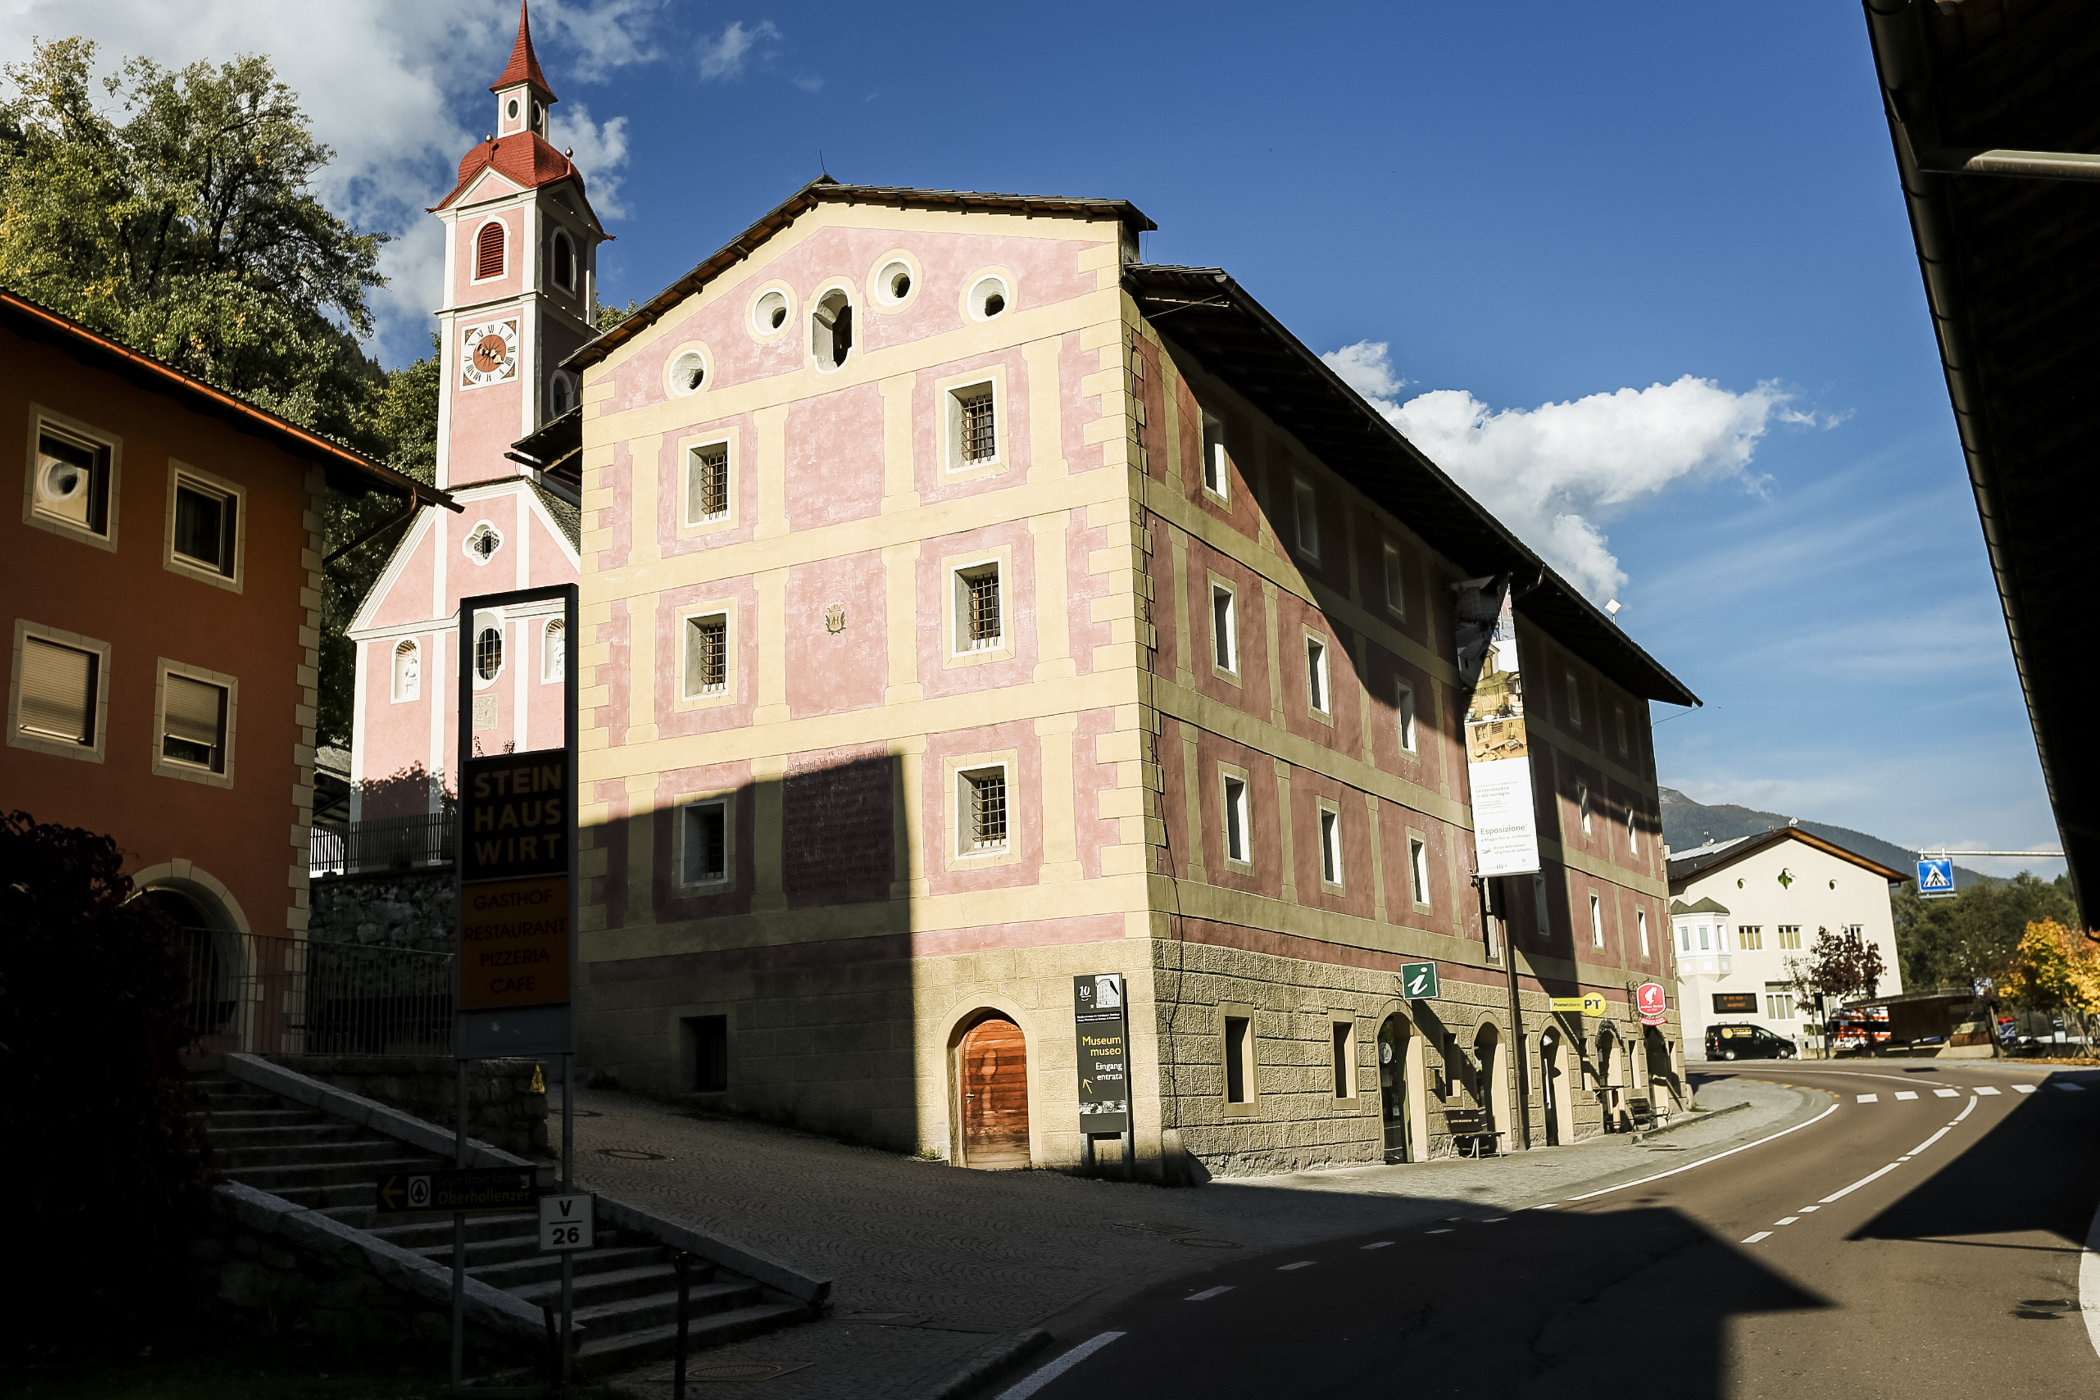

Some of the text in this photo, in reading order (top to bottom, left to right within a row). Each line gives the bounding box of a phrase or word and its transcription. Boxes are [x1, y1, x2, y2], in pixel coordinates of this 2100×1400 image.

[473, 763, 562, 799] STEIN
[473, 799, 562, 833] HAUS
[1480, 824, 1526, 836] Esposizione
[473, 832, 562, 867] WIRT
[473, 889, 553, 911] GASTHOF
[464, 919, 566, 941] RESTAURANT
[480, 948, 550, 967] PIZZERIA
[490, 976, 535, 994] CAFE
[1079, 985, 1090, 997] 10
[1584, 999, 1601, 1010] PT
[1082, 1035, 1122, 1046] Museum
[1090, 1047, 1122, 1057] museo
[1095, 1062, 1123, 1072] Eingang
[1096, 1073, 1123, 1081] entrata
[438, 1187, 530, 1206] Oberhollenzer
[559, 1200, 572, 1217] V
[552, 1227, 579, 1245] 26
